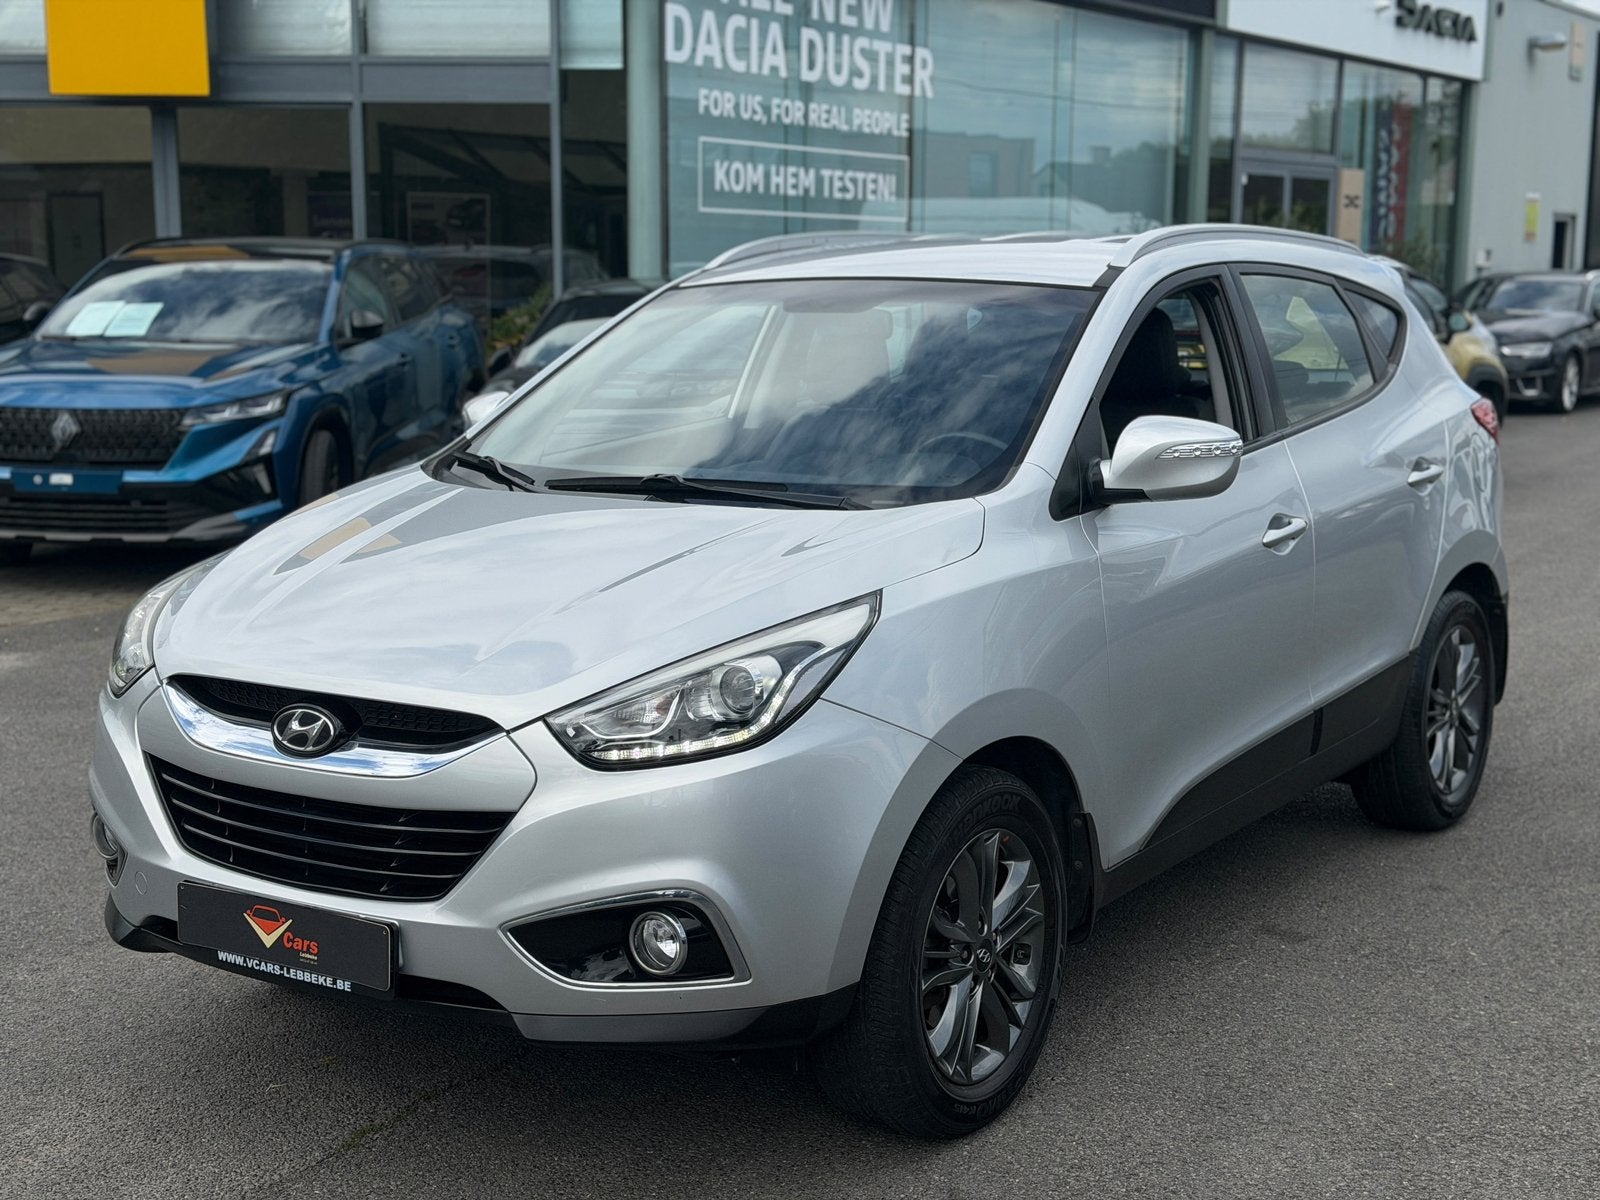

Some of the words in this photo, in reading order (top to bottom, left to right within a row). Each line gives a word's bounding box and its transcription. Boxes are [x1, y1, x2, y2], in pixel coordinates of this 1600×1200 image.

[664, 2, 788, 79] DACIA
[800, 26, 934, 98] DUSTER
[698, 88, 735, 118] FOR
[739, 95, 768, 125] US,
[771, 98, 805, 126] FOR
[808, 102, 849, 132] REAL
[852, 108, 910, 137] PEOPLE
[714, 159, 764, 194] KOM
[770, 164, 815, 197] HEM
[820, 169, 897, 201] TESTEN!
[283, 931, 319, 955] Cars
[217, 950, 352, 992] WWW.VCARS-LEBBEKE.BE
